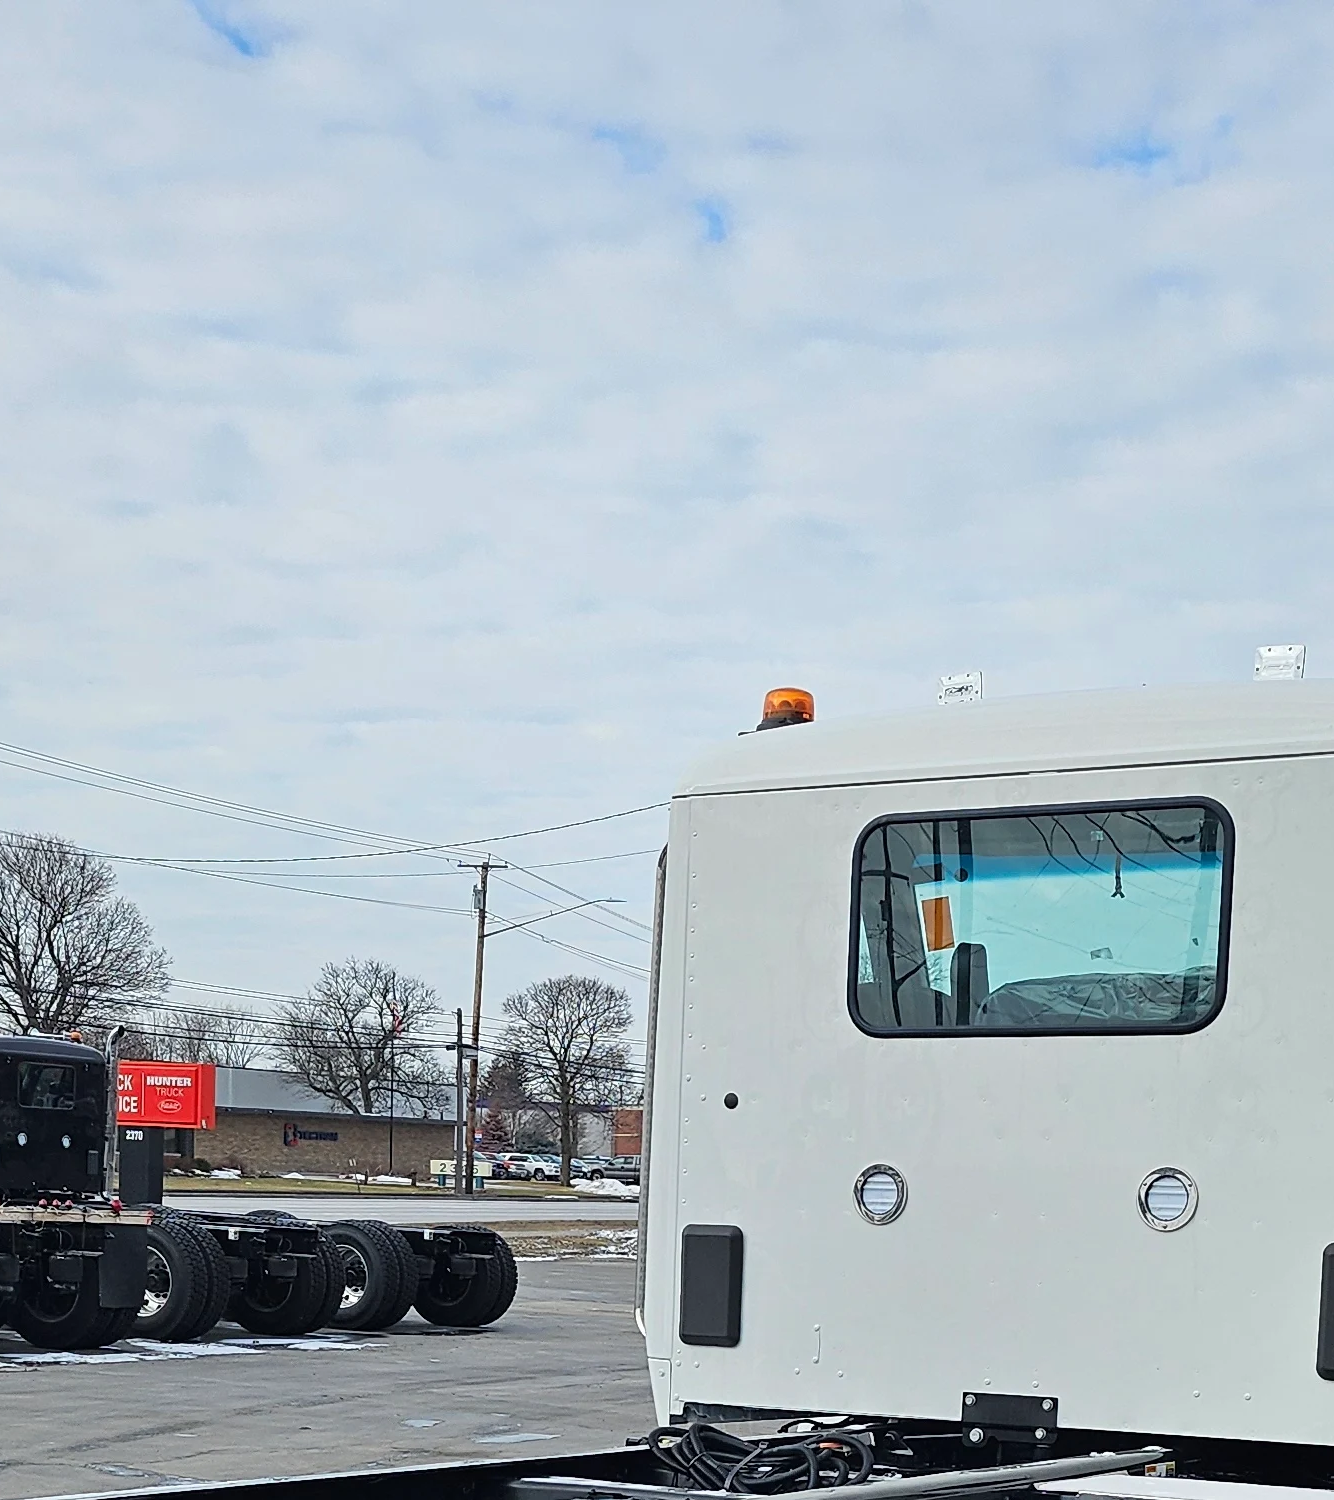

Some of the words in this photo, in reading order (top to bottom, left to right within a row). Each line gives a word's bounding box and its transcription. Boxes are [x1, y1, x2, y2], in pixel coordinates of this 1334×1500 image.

[117, 1075, 133, 1091] CK
[146, 1076, 192, 1087] HUNTER
[156, 1087, 184, 1097] TRUCK
[118, 1096, 138, 1113] ICE
[125, 1130, 143, 1141] 2370
